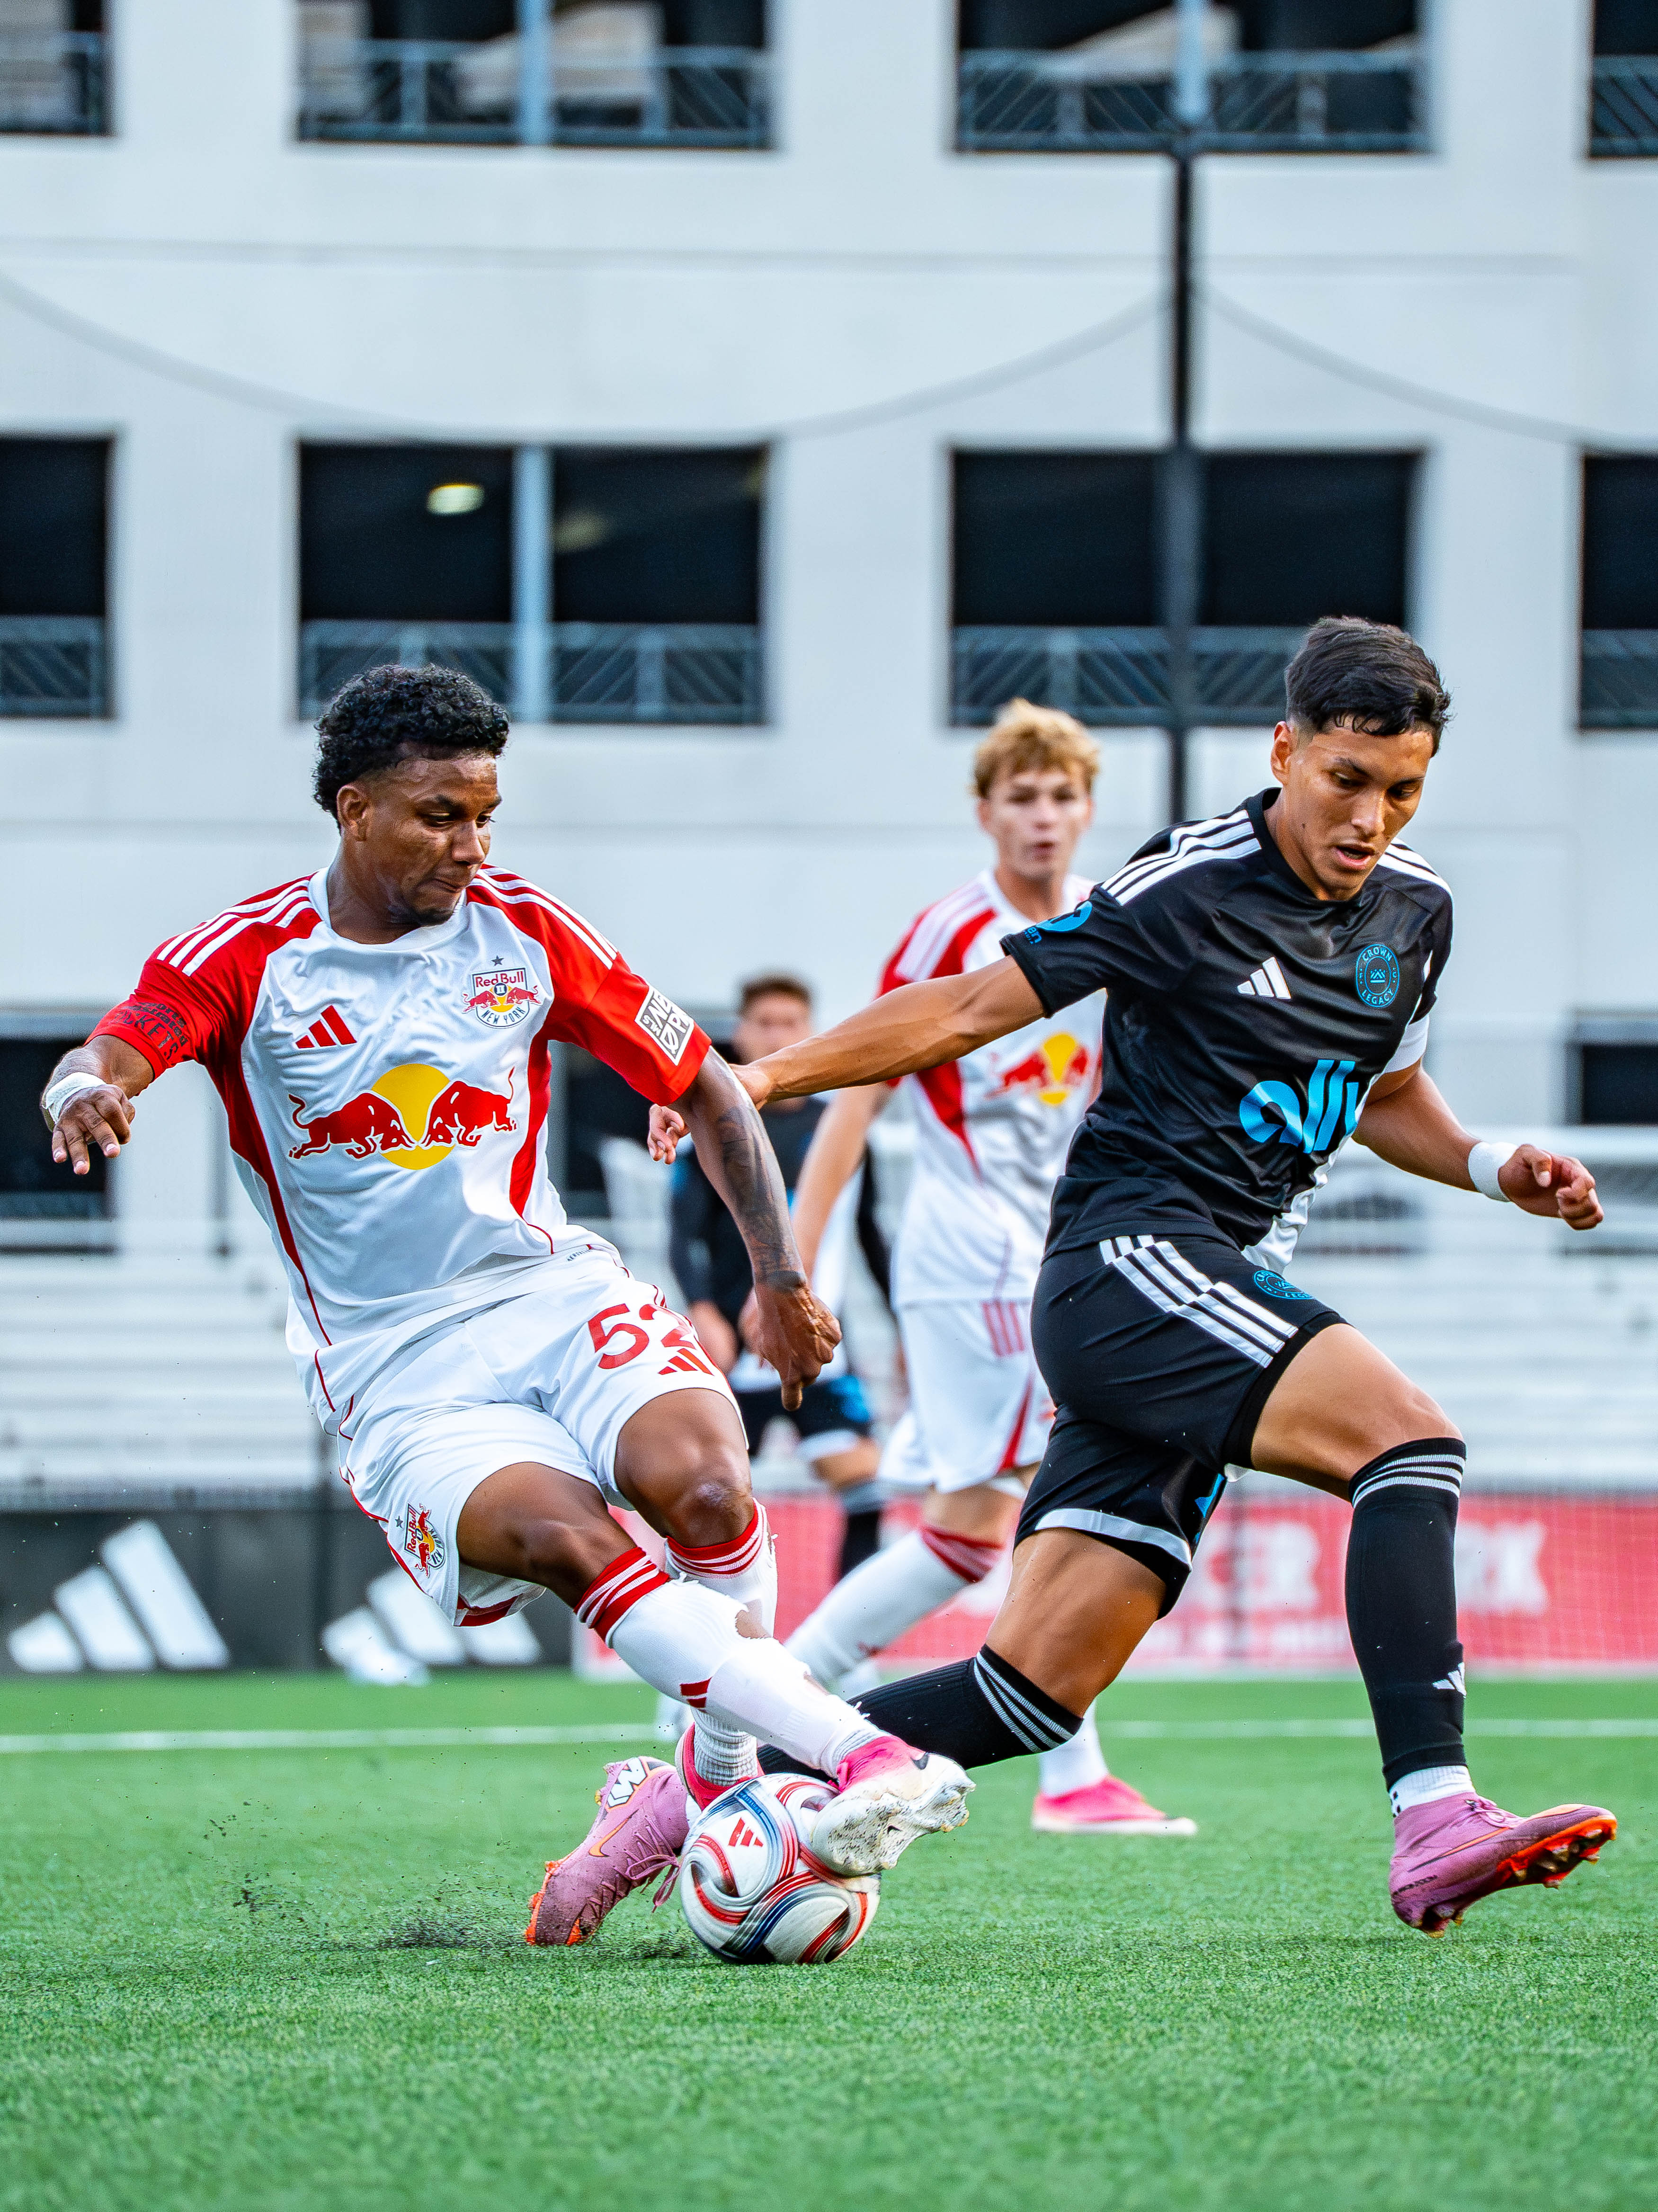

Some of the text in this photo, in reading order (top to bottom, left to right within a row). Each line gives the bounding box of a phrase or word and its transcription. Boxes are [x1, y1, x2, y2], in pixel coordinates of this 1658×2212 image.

[1362, 947, 1392, 961] CROWN
[475, 971, 524, 988] Red Bull
[1362, 989, 1393, 1005] LEGACY
[481, 1007, 526, 1024] NEW YORK
[588, 1303, 696, 1369] 52
[407, 1507, 417, 1552] Red Bull
